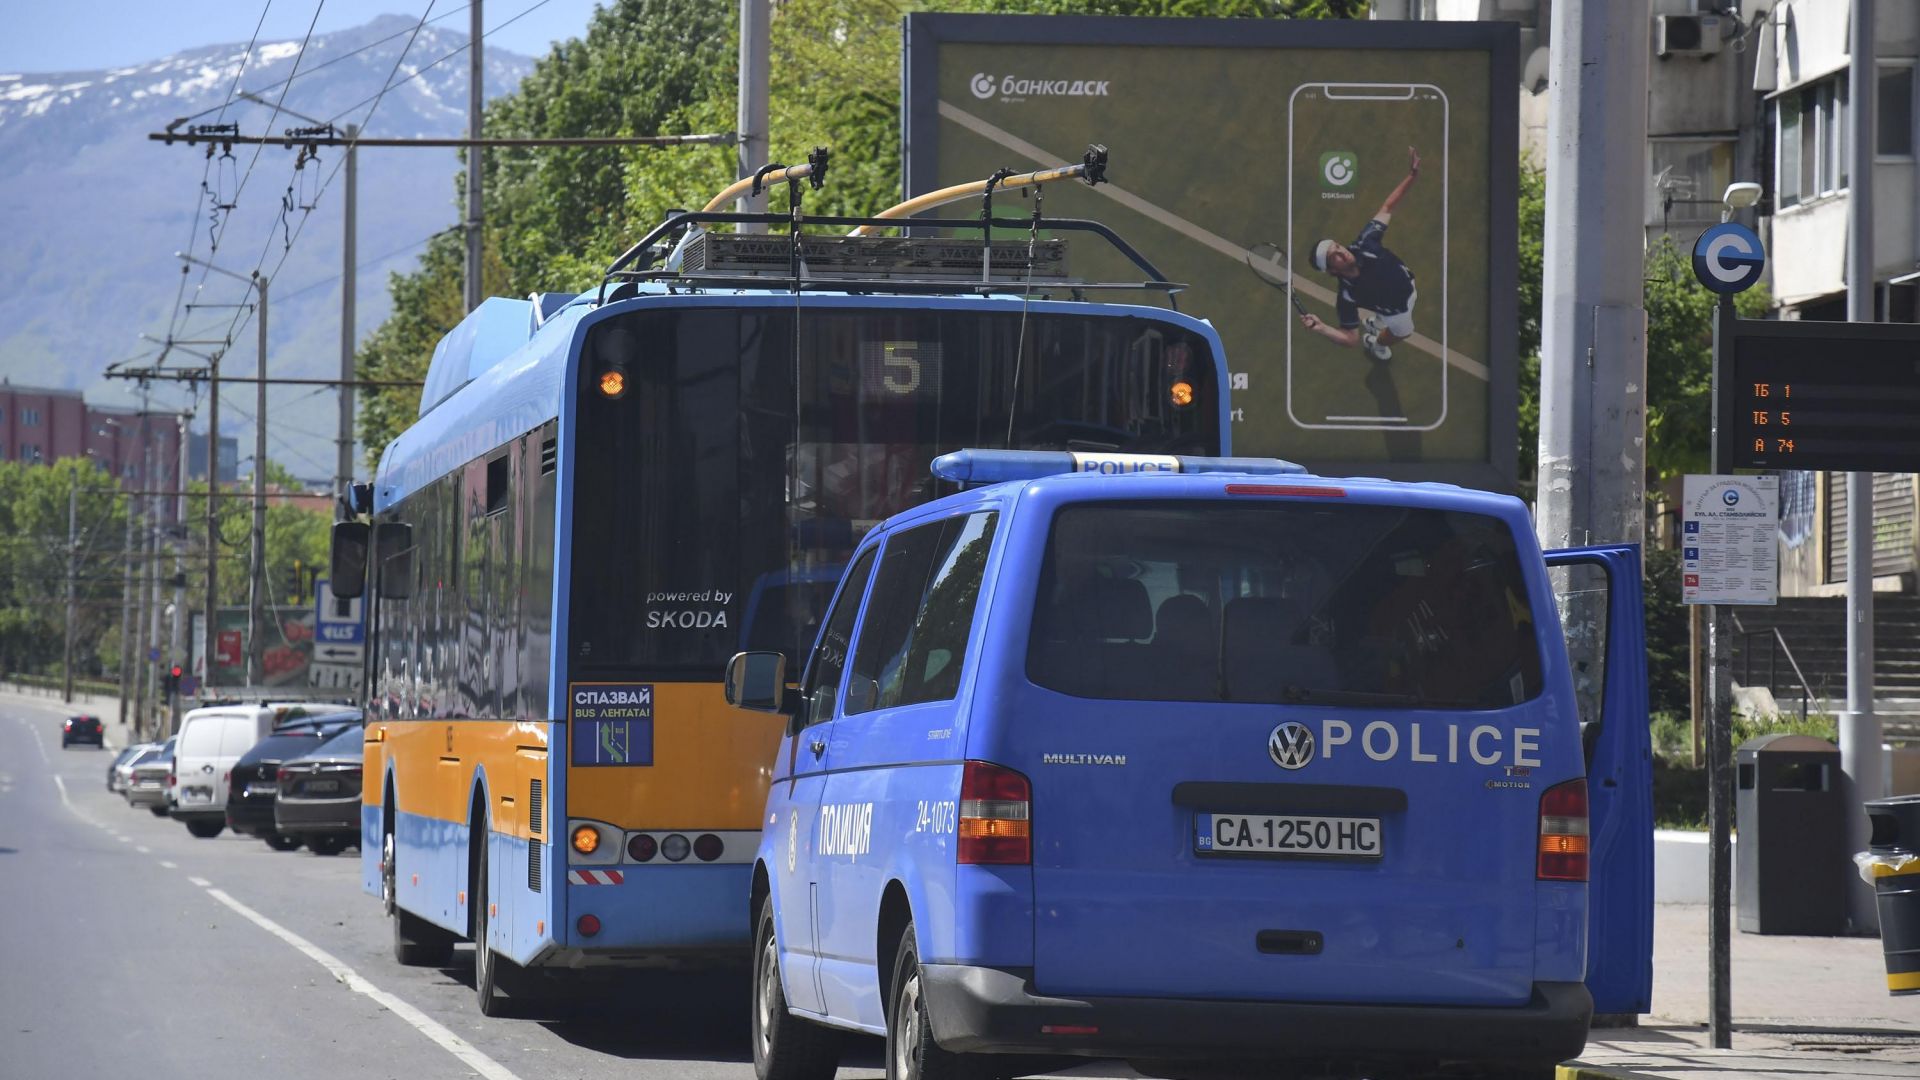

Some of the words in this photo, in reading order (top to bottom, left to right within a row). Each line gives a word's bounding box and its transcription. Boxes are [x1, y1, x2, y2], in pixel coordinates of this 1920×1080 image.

[884, 341, 920, 393] 5
[1754, 383, 1769, 397] ТБ
[1784, 384, 1791, 398] 1
[1753, 411, 1768, 425] ТБ
[1781, 412, 1791, 425] 5
[1777, 439, 1795, 452] 74
[646, 590, 711, 604] powered
[714, 589, 733, 604] by
[646, 610, 728, 628] SKODA
[575, 688, 650, 705] СПАЗВАЙ
[575, 708, 596, 718] BUS
[600, 708, 650, 718] ЛЕНТАТА!
[1322, 719, 1541, 768] POLICE
[1043, 752, 1127, 765] MULTIVAN
[915, 800, 956, 834] 24-1073
[819, 802, 873, 864] ПОЛИЦИЯ
[1199, 836, 1212, 846] BG
[1215, 817, 1254, 848] CA
[1263, 819, 1332, 849] 1250
[1337, 821, 1376, 851] HC
